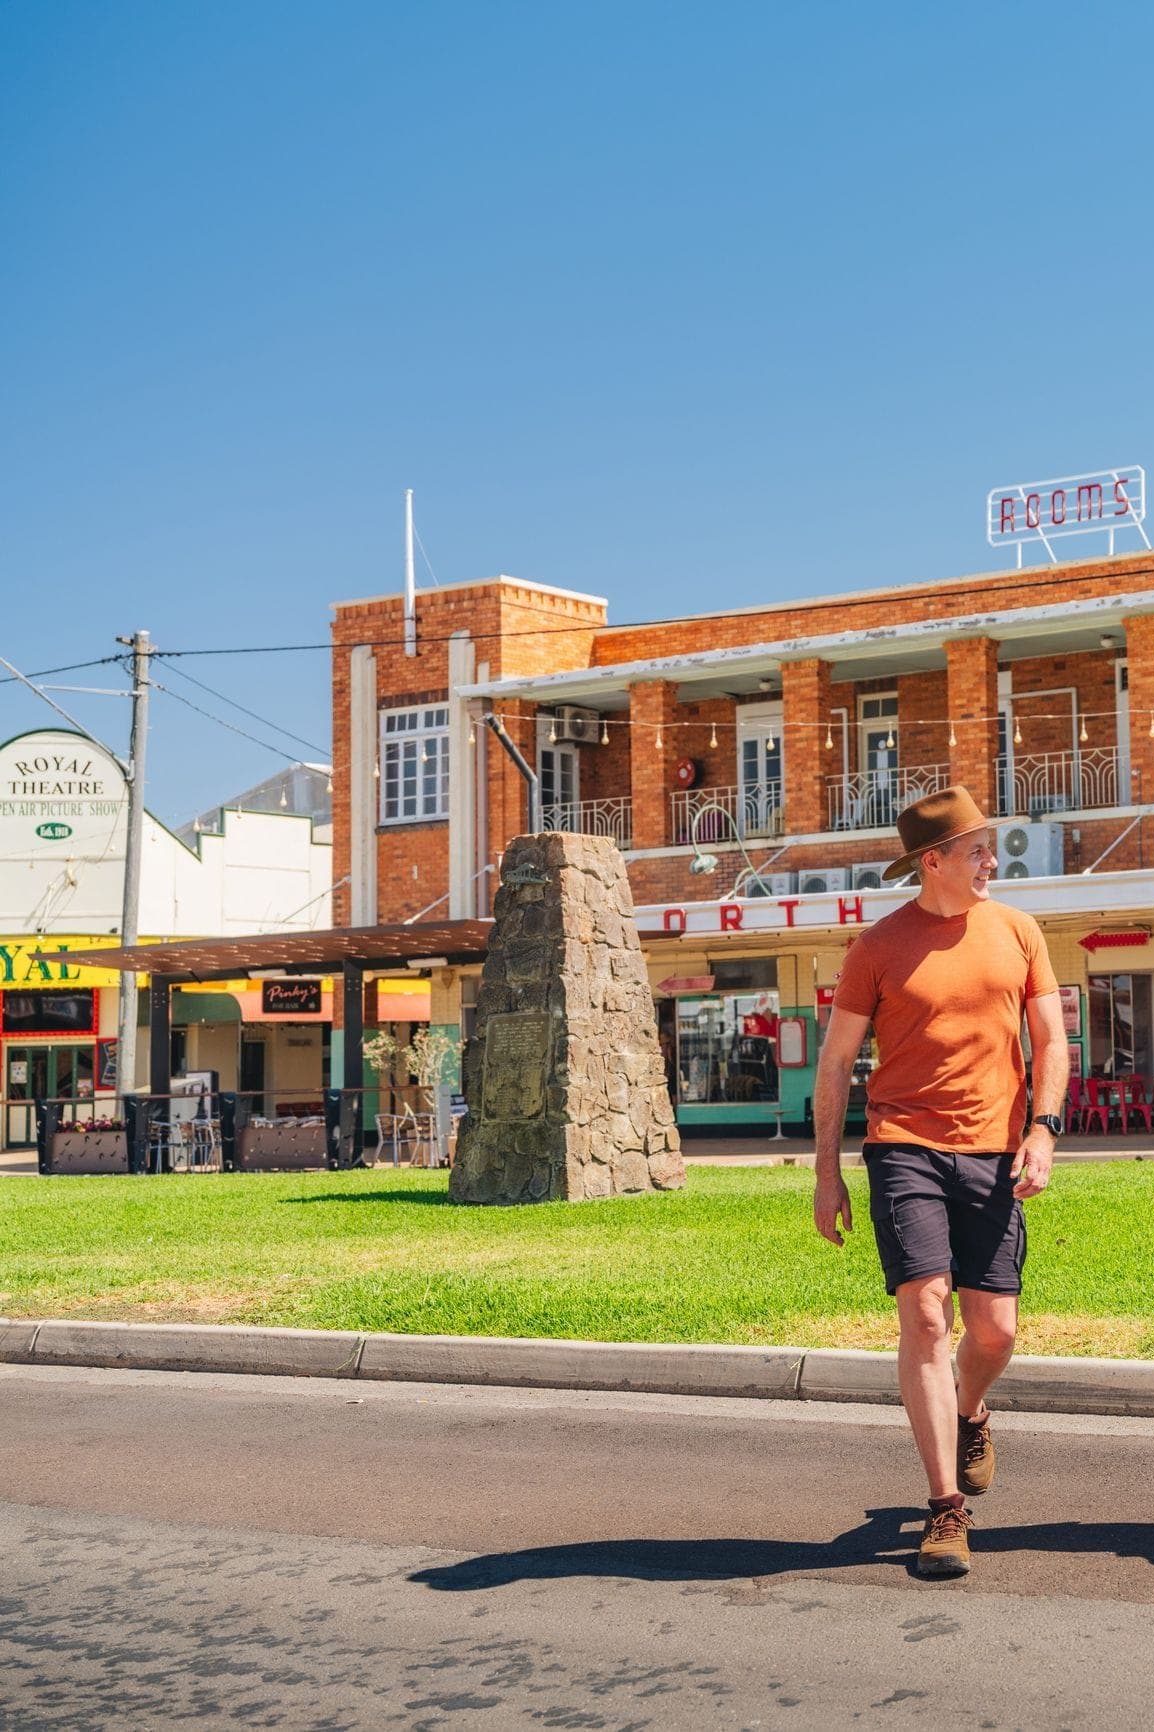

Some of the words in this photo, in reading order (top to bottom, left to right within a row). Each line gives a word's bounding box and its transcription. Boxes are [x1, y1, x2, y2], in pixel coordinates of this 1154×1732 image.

[1001, 479, 1128, 533] ROOMS
[15, 757, 94, 776] ROYAL
[8, 781, 104, 795] THEATRE
[19, 802, 36, 816] AIR
[41, 802, 82, 816] PICTURE
[90, 802, 118, 816] SHOW
[663, 896, 863, 931] ORTH
[0, 945, 80, 981] YAL
[266, 985, 319, 1002] Pinky's
